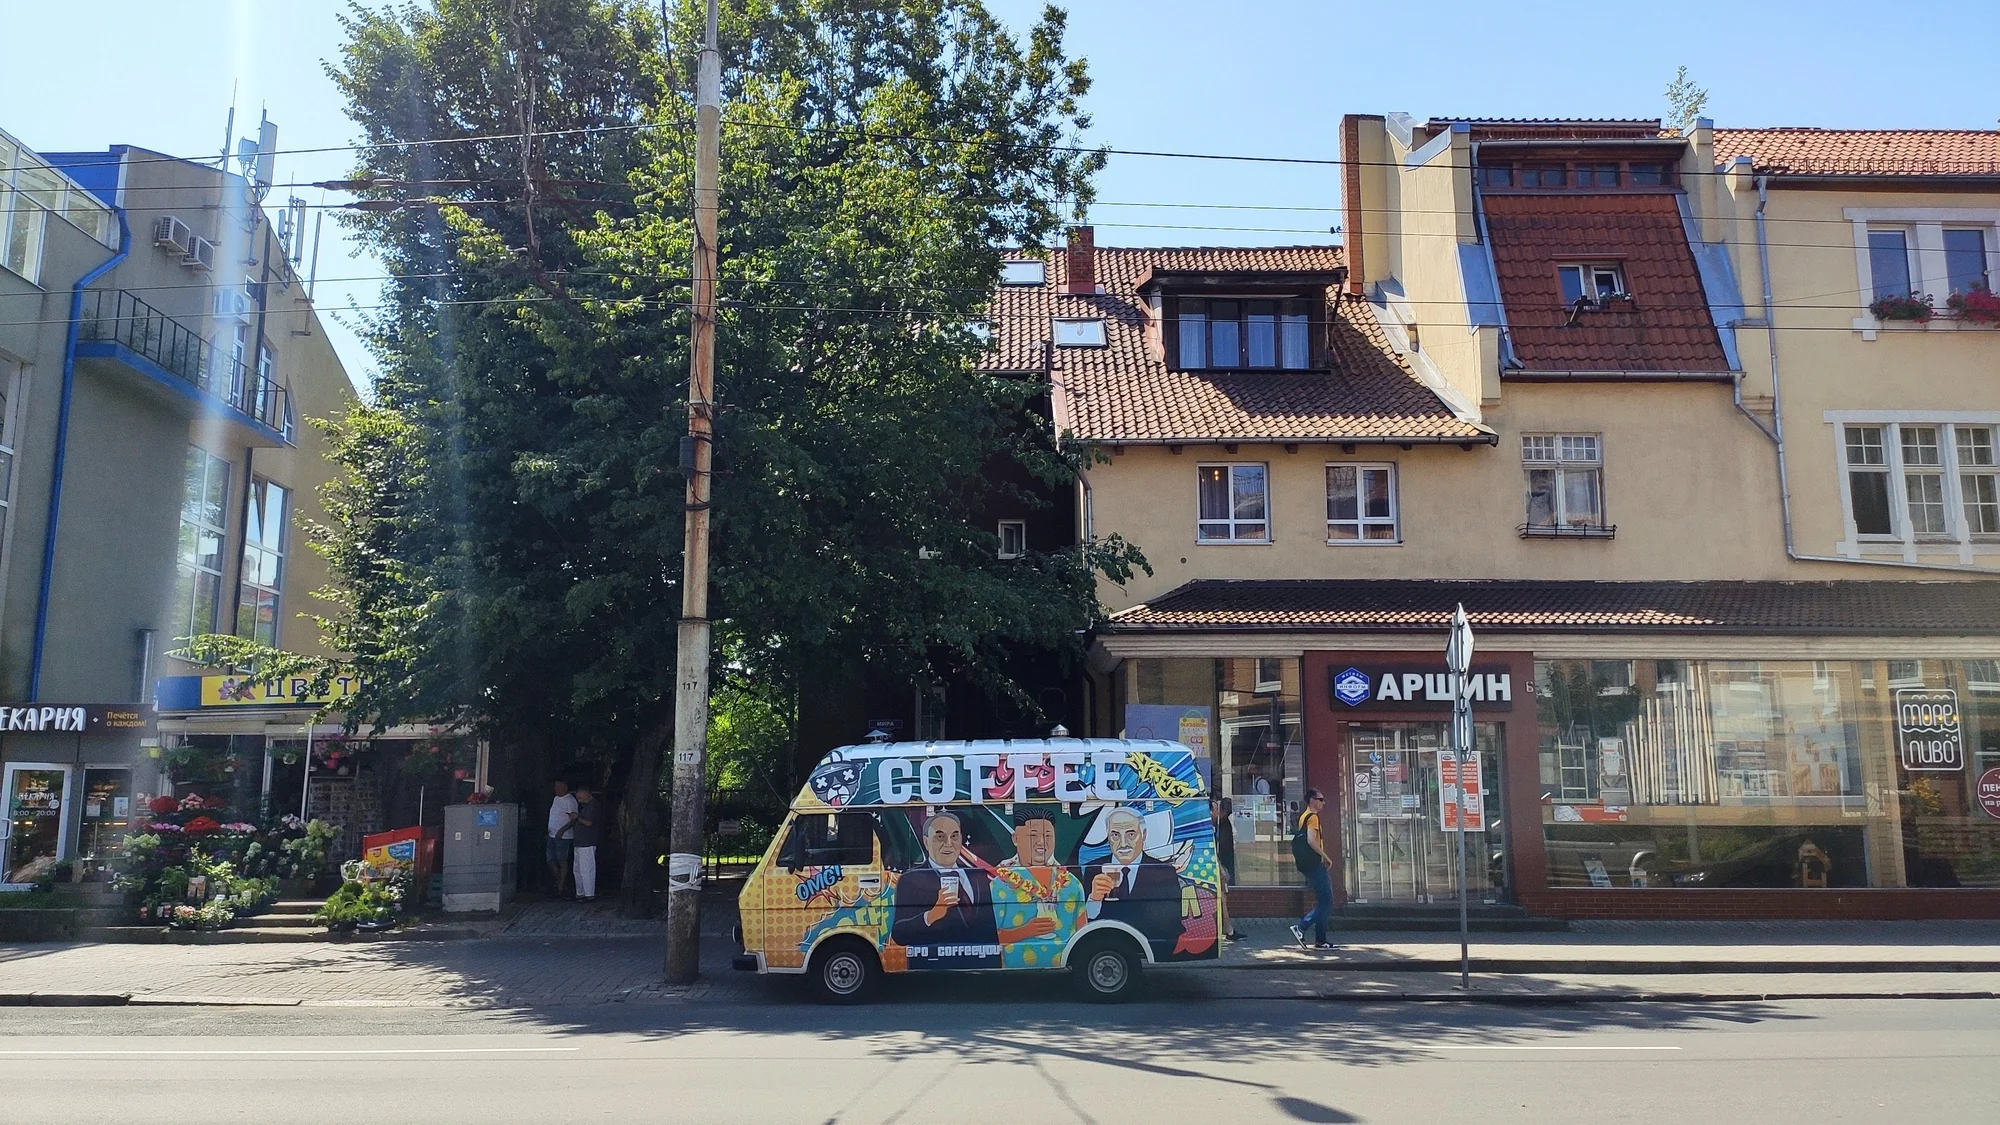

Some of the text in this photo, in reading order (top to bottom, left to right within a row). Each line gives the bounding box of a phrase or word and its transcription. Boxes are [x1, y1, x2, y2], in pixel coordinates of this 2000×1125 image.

[682, 681, 697, 690] 117
[1376, 673, 1511, 701] АРШИН
[678, 752, 694, 762] 117
[878, 751, 1127, 803] COFFEE
[795, 864, 844, 901] OMG!
